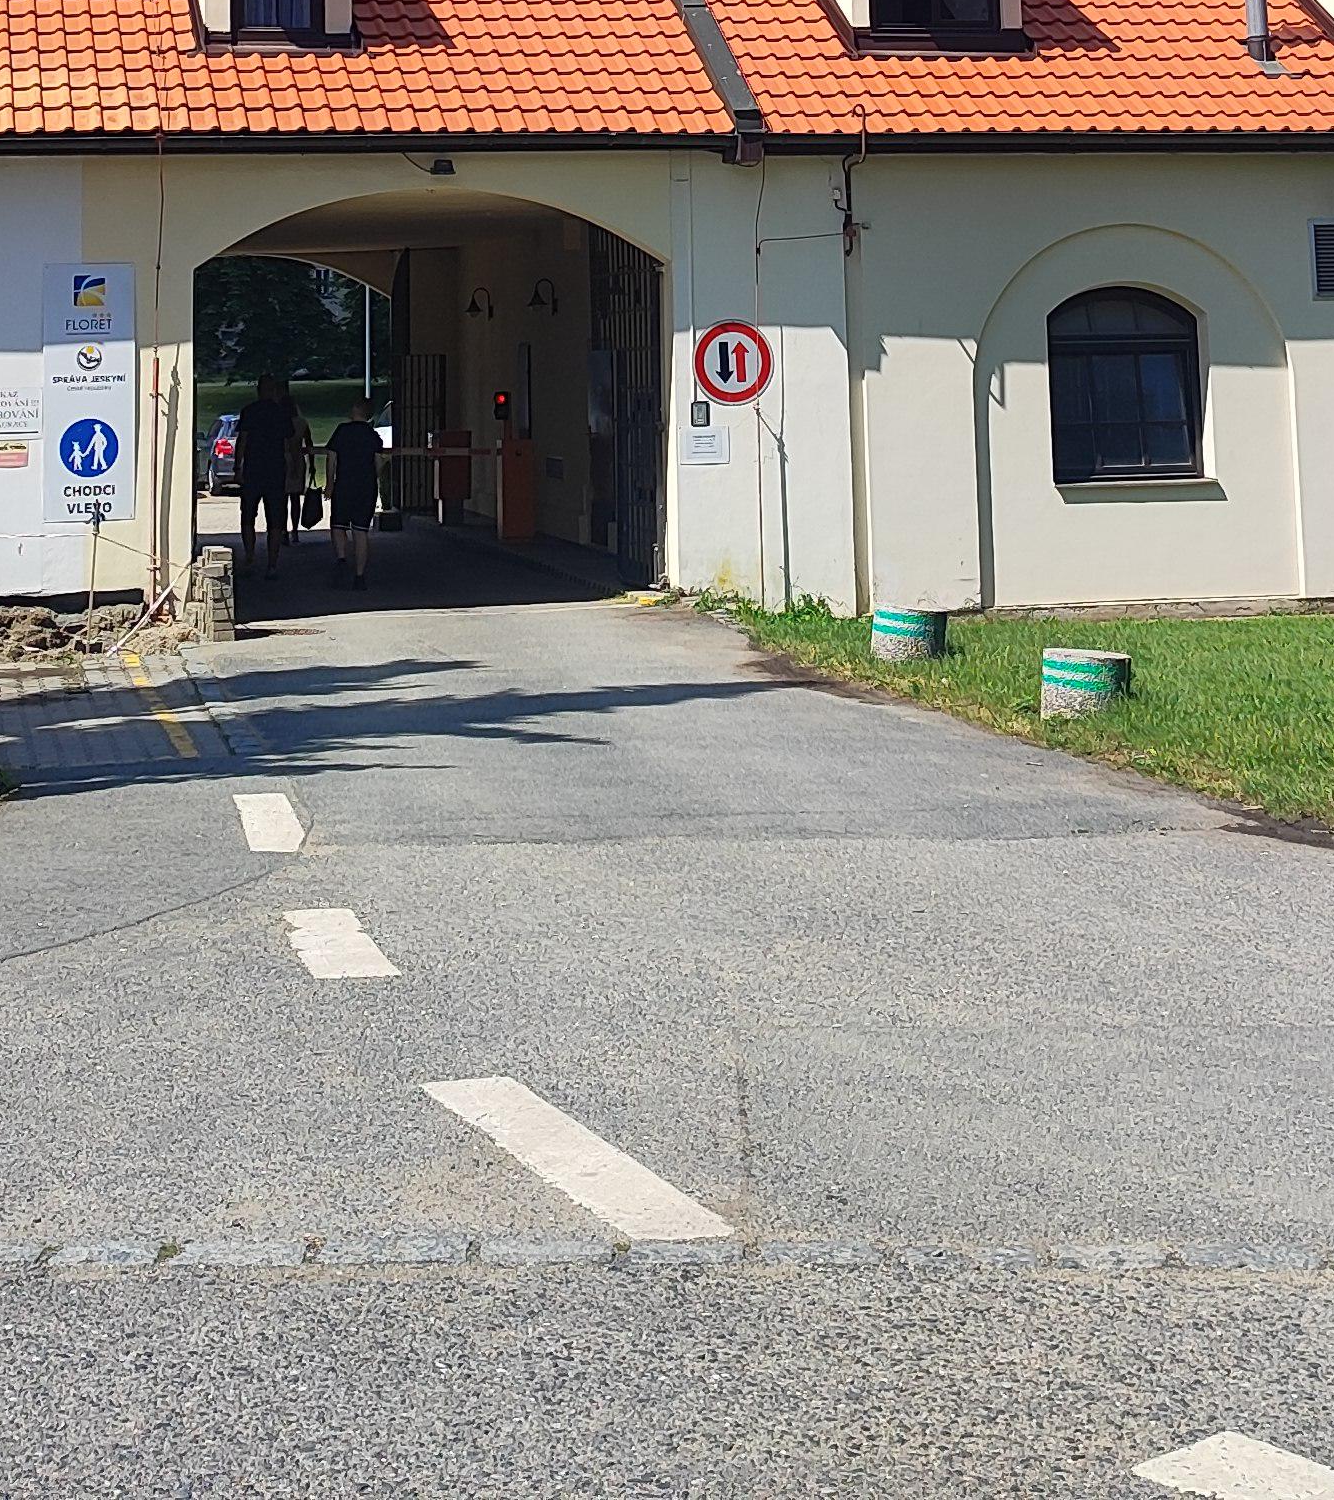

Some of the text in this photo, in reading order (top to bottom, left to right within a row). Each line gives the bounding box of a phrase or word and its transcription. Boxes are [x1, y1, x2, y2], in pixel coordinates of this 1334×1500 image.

[65, 319, 112, 330] FLORET
[52, 373, 126, 384] SPRÁVA JESKYNÍ
[63, 484, 116, 498] CHODCI
[66, 502, 113, 515] VLEVO
